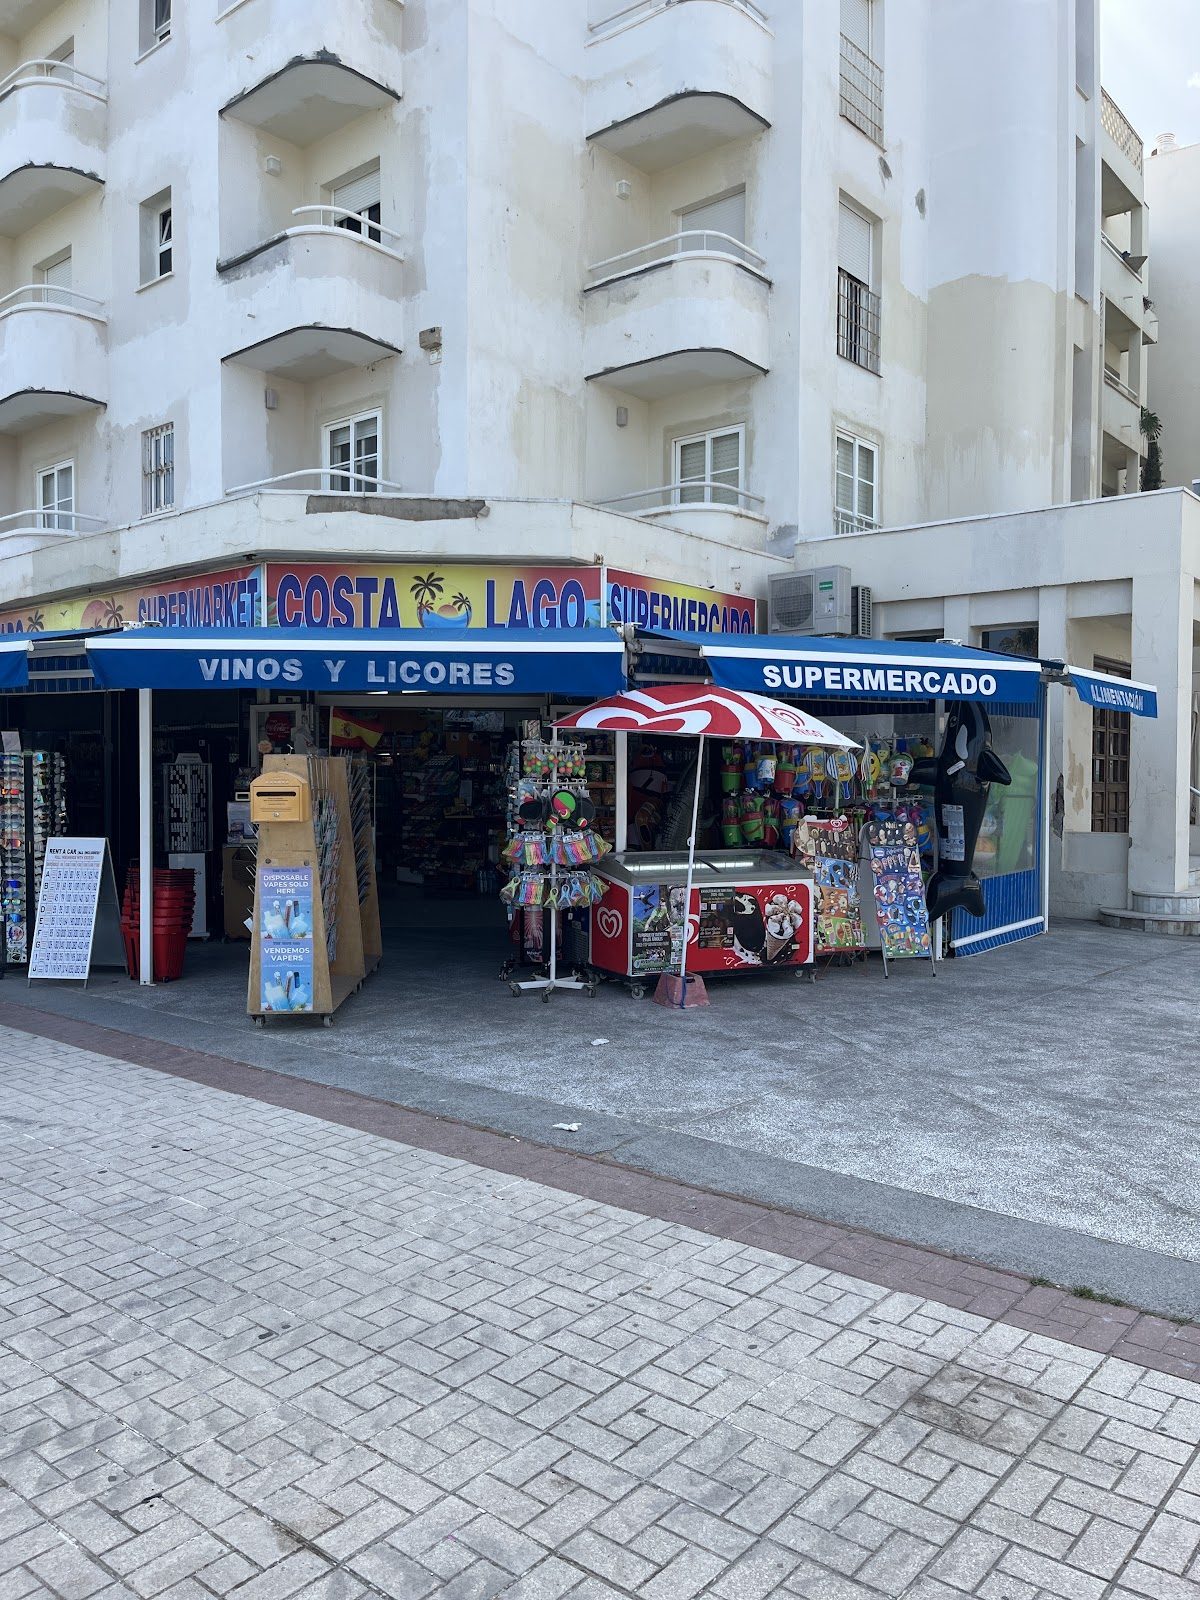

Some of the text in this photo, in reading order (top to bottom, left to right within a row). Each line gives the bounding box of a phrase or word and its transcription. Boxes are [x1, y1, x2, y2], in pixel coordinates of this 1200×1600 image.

[138, 577, 258, 628] SUPERMARKET
[276, 573, 586, 628] COSTA LAGO
[610, 583, 751, 634] SUPERMERCADO
[199, 658, 515, 685] VINOS Y LICORES
[762, 665, 997, 696] SUPERMERCADO
[1090, 684, 1144, 711] ALIMENTACIÓN
